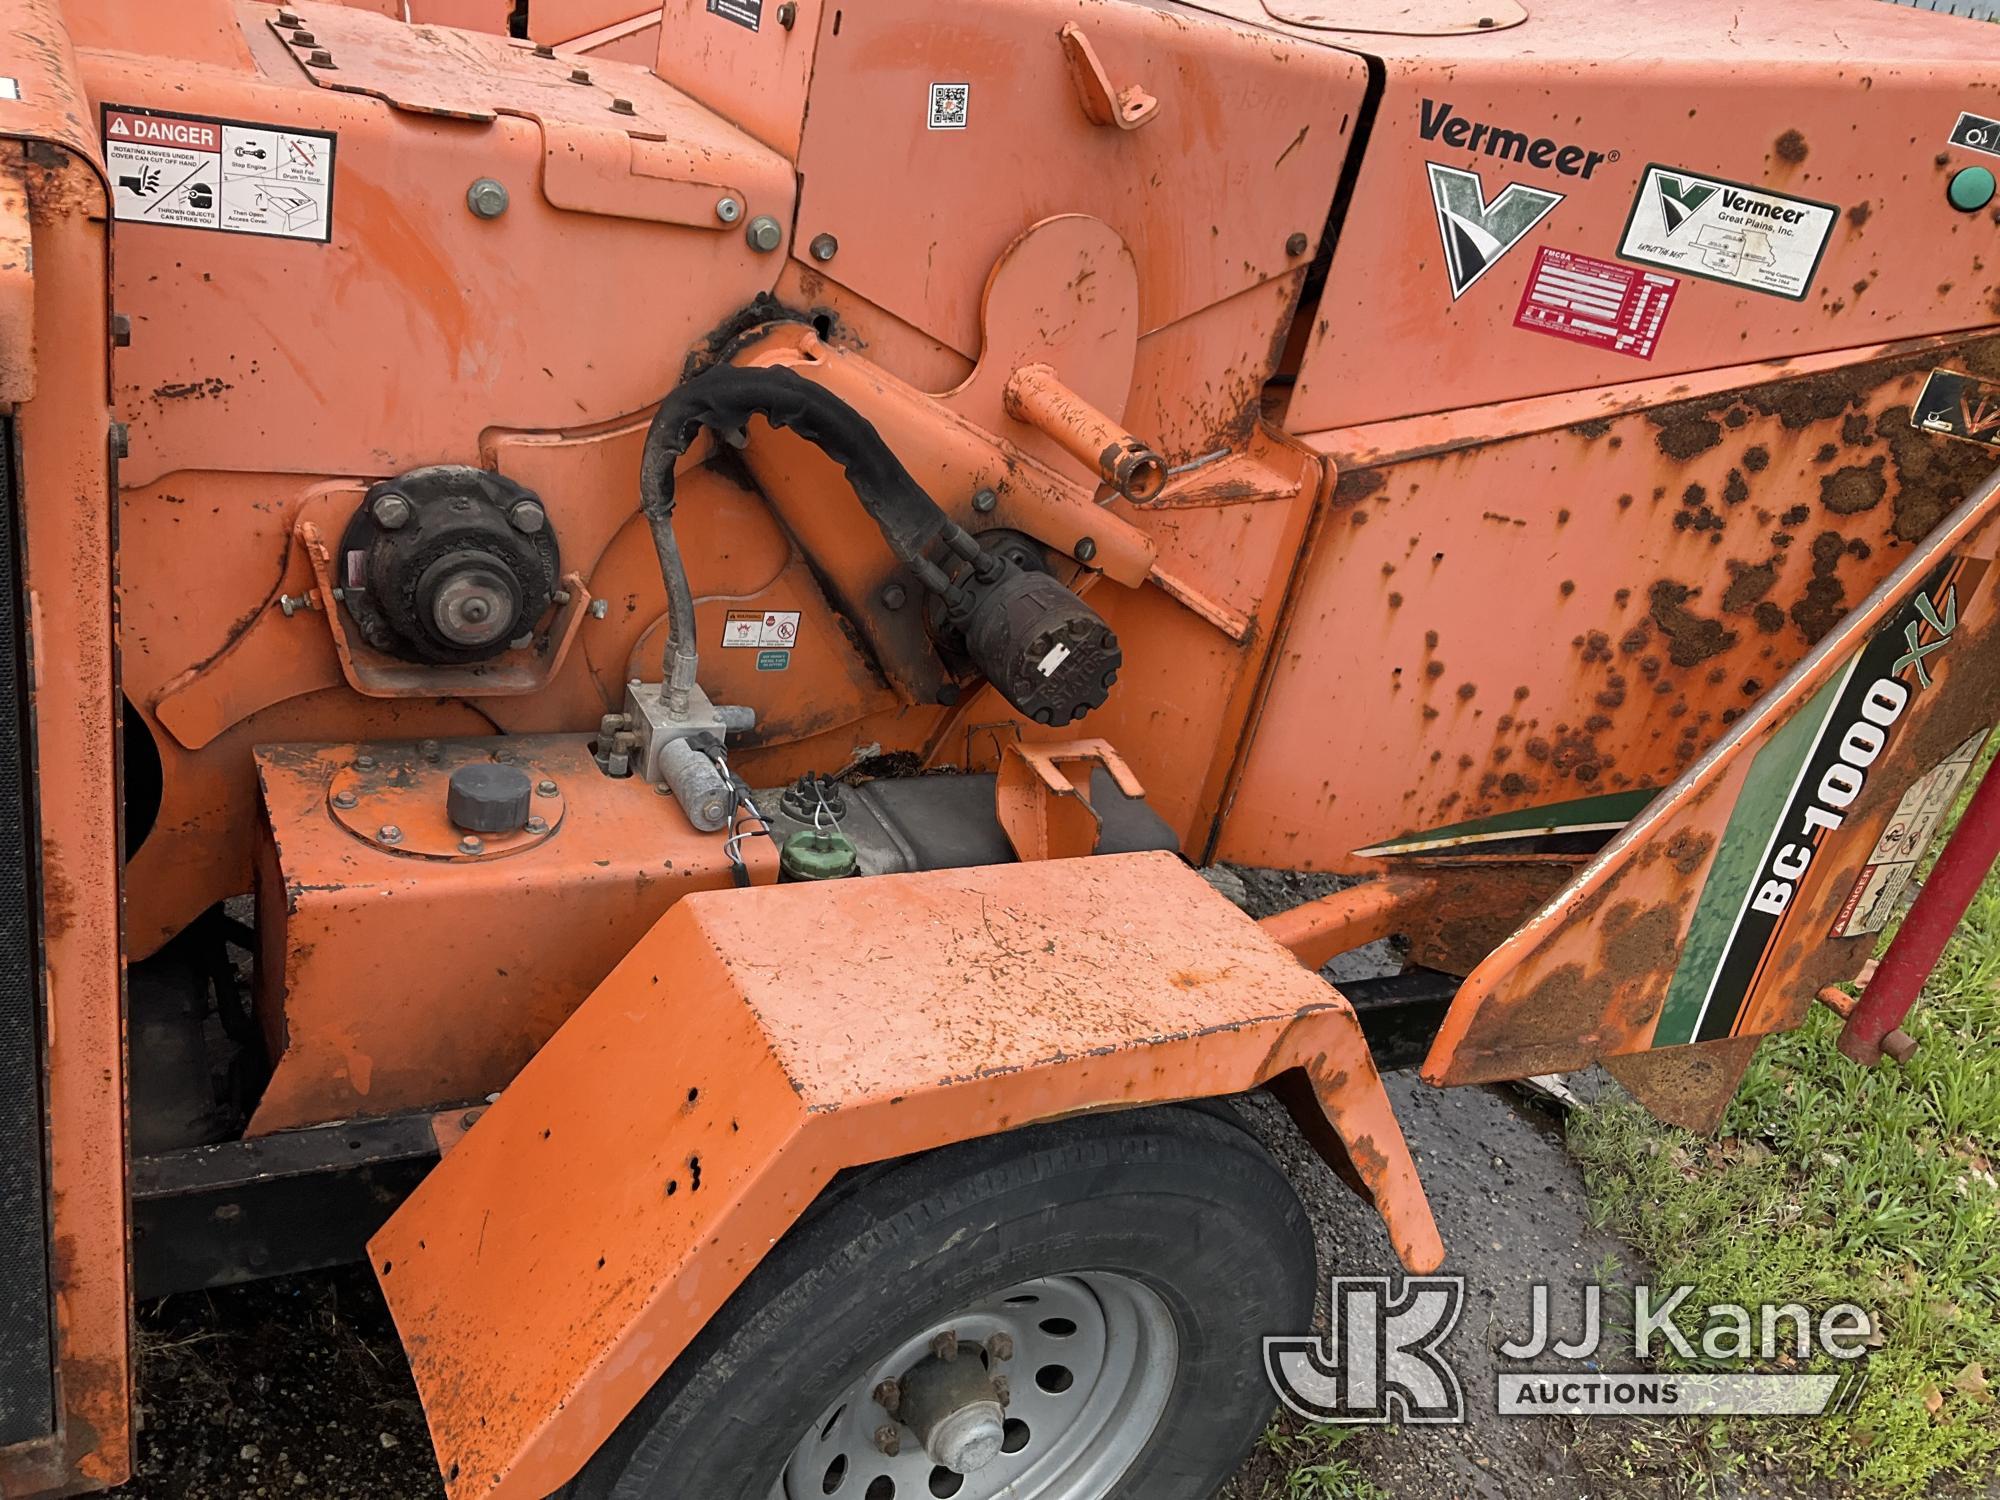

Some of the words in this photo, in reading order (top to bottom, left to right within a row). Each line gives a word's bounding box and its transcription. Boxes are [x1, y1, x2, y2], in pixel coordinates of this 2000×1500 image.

[134, 120, 214, 146] DANGER
[113, 145, 146, 155] ROTATING
[147, 150, 171, 158] KNIVES
[111, 152, 134, 161] COVER
[150, 156, 163, 164] CUT
[178, 160, 197, 168] HAND
[231, 161, 246, 169] Stop
[246, 163, 267, 171] Engine
[157, 207, 185, 215] THROWN
[186, 210, 215, 218] OBJECTS
[175, 215, 198, 223] STRIKE
[228, 215, 249, 223] Access
[248, 211, 264, 219] Open
[1718, 212, 1743, 226] Great
[1744, 218, 1775, 234] Plains,
[1777, 226, 1795, 237] Inc.
[1543, 248, 1571, 261] FMCSA
[1840, 869, 1873, 918] DANGER
